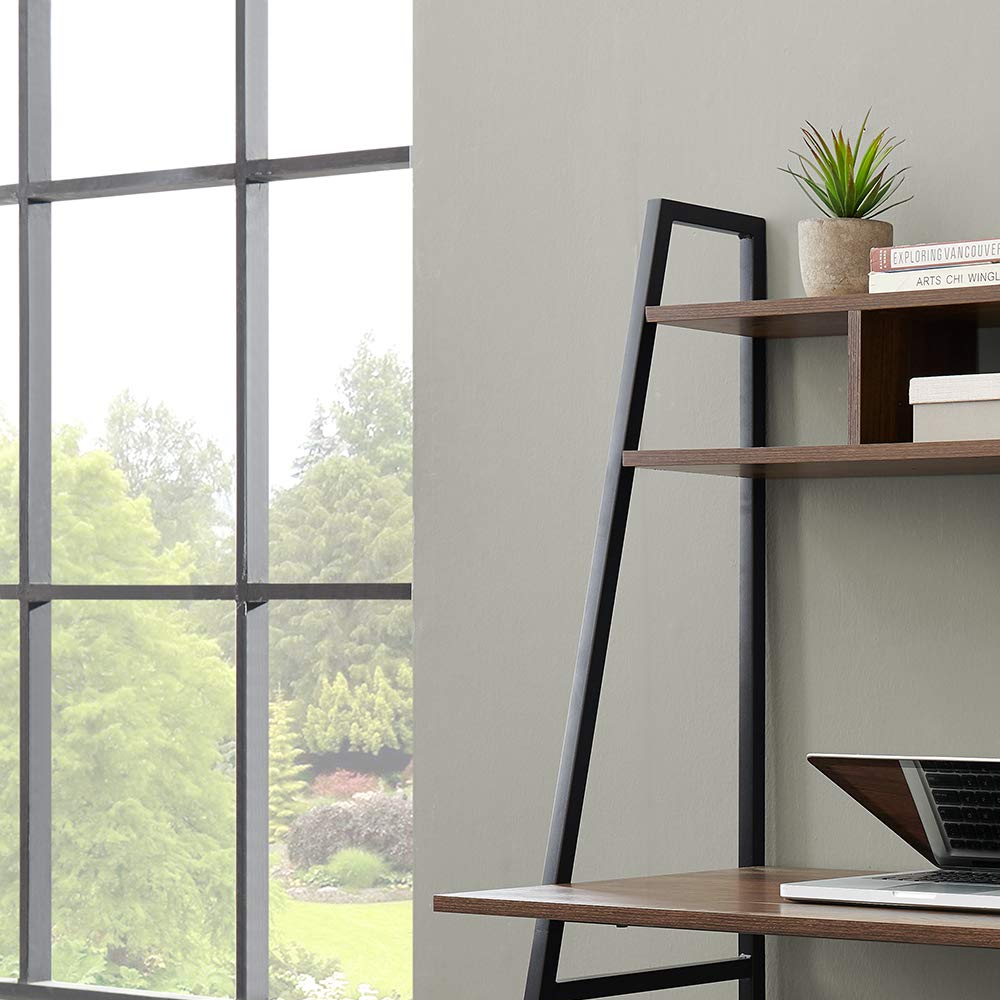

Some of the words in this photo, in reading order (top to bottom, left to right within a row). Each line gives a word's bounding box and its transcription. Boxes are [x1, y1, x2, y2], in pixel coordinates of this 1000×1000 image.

[893, 247, 942, 265] EXPLORING
[916, 275, 942, 286] ARTS
[946, 274, 963, 285] CHI
